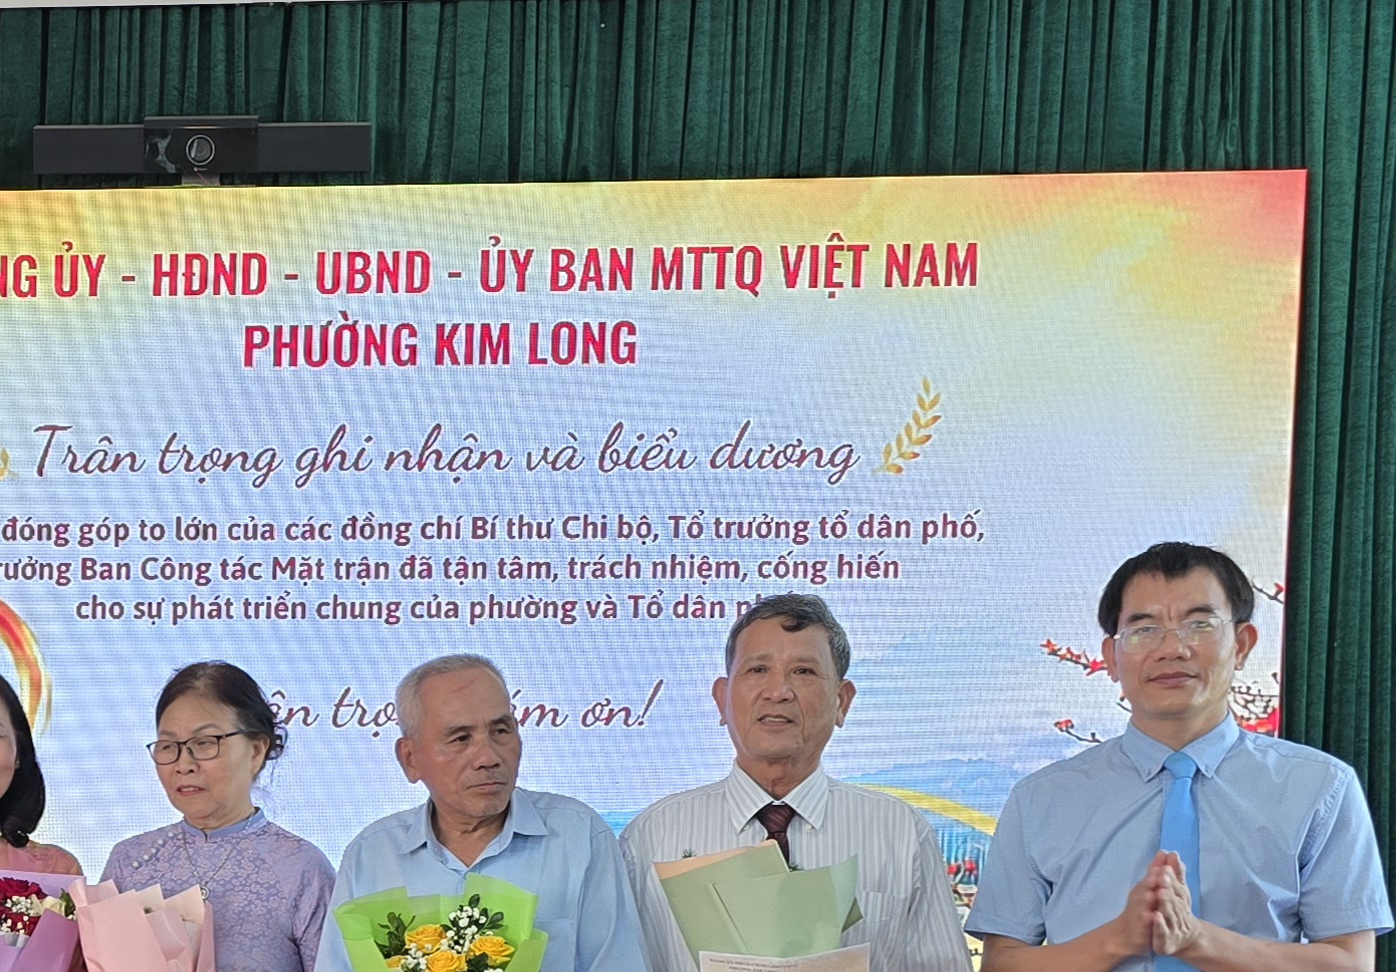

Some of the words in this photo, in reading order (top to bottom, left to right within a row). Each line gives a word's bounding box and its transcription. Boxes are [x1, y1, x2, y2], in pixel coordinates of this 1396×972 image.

[55, 242, 105, 297] ỦY
[153, 252, 268, 296] HĐND
[315, 249, 431, 294] UBND
[480, 236, 535, 293] ỦY
[550, 247, 634, 292] BAN
[651, 245, 762, 297] MTTQ
[781, 233, 869, 298] VIỆT
[884, 242, 978, 287] NAM
[244, 310, 418, 367] PHƯỜNG
[435, 322, 510, 366] KIM
[529, 321, 637, 365] LONG
[33, 424, 146, 478] Trân
[158, 432, 283, 488] trọng
[295, 424, 373, 488] ghi
[384, 423, 513, 483] nhận
[526, 432, 585, 471] và
[598, 422, 697, 473] biểu
[709, 420, 861, 485] dương
[2, 516, 69, 546] đóng
[78, 517, 129, 546] góp
[138, 520, 165, 541] to
[175, 516, 218, 541] lớn
[227, 516, 276, 541] của
[285, 516, 333, 541] các
[341, 511, 411, 545] đồng
[420, 515, 462, 540] chí
[472, 515, 498, 540] Bí
[506, 515, 553, 540] thư
[562, 514, 608, 540] Chi
[617, 514, 659, 545] bộ,
[668, 510, 704, 540] Tổ
[713, 513, 808, 544] trưởng
[819, 510, 848, 539] tổ
[857, 514, 911, 539] dân
[922, 509, 985, 544] phố,
[81, 557, 130, 581] Ban
[141, 555, 211, 585] Công
[219, 555, 262, 581] tác
[271, 557, 325, 586] Mặt
[334, 556, 389, 586] trận
[398, 555, 433, 581] đã
[443, 556, 488, 586] tận
[497, 556, 559, 585] tâm,
[568, 554, 641, 580] trách
[651, 554, 748, 585] nhiệm,
[757, 549, 827, 584] cống
[836, 549, 898, 579] hiến
[76, 596, 125, 620] cho
[134, 598, 166, 626] sự
[172, 595, 233, 626] phát
[243, 588, 306, 620] triển
[316, 595, 401, 625] chung
[410, 595, 459, 620] của
[469, 595, 578, 625] phường
[586, 594, 618, 618] và
[628, 590, 663, 619] Tổ
[673, 594, 726, 618] dân
[331, 686, 401, 738] trọ
[582, 679, 663, 728] ơn!
